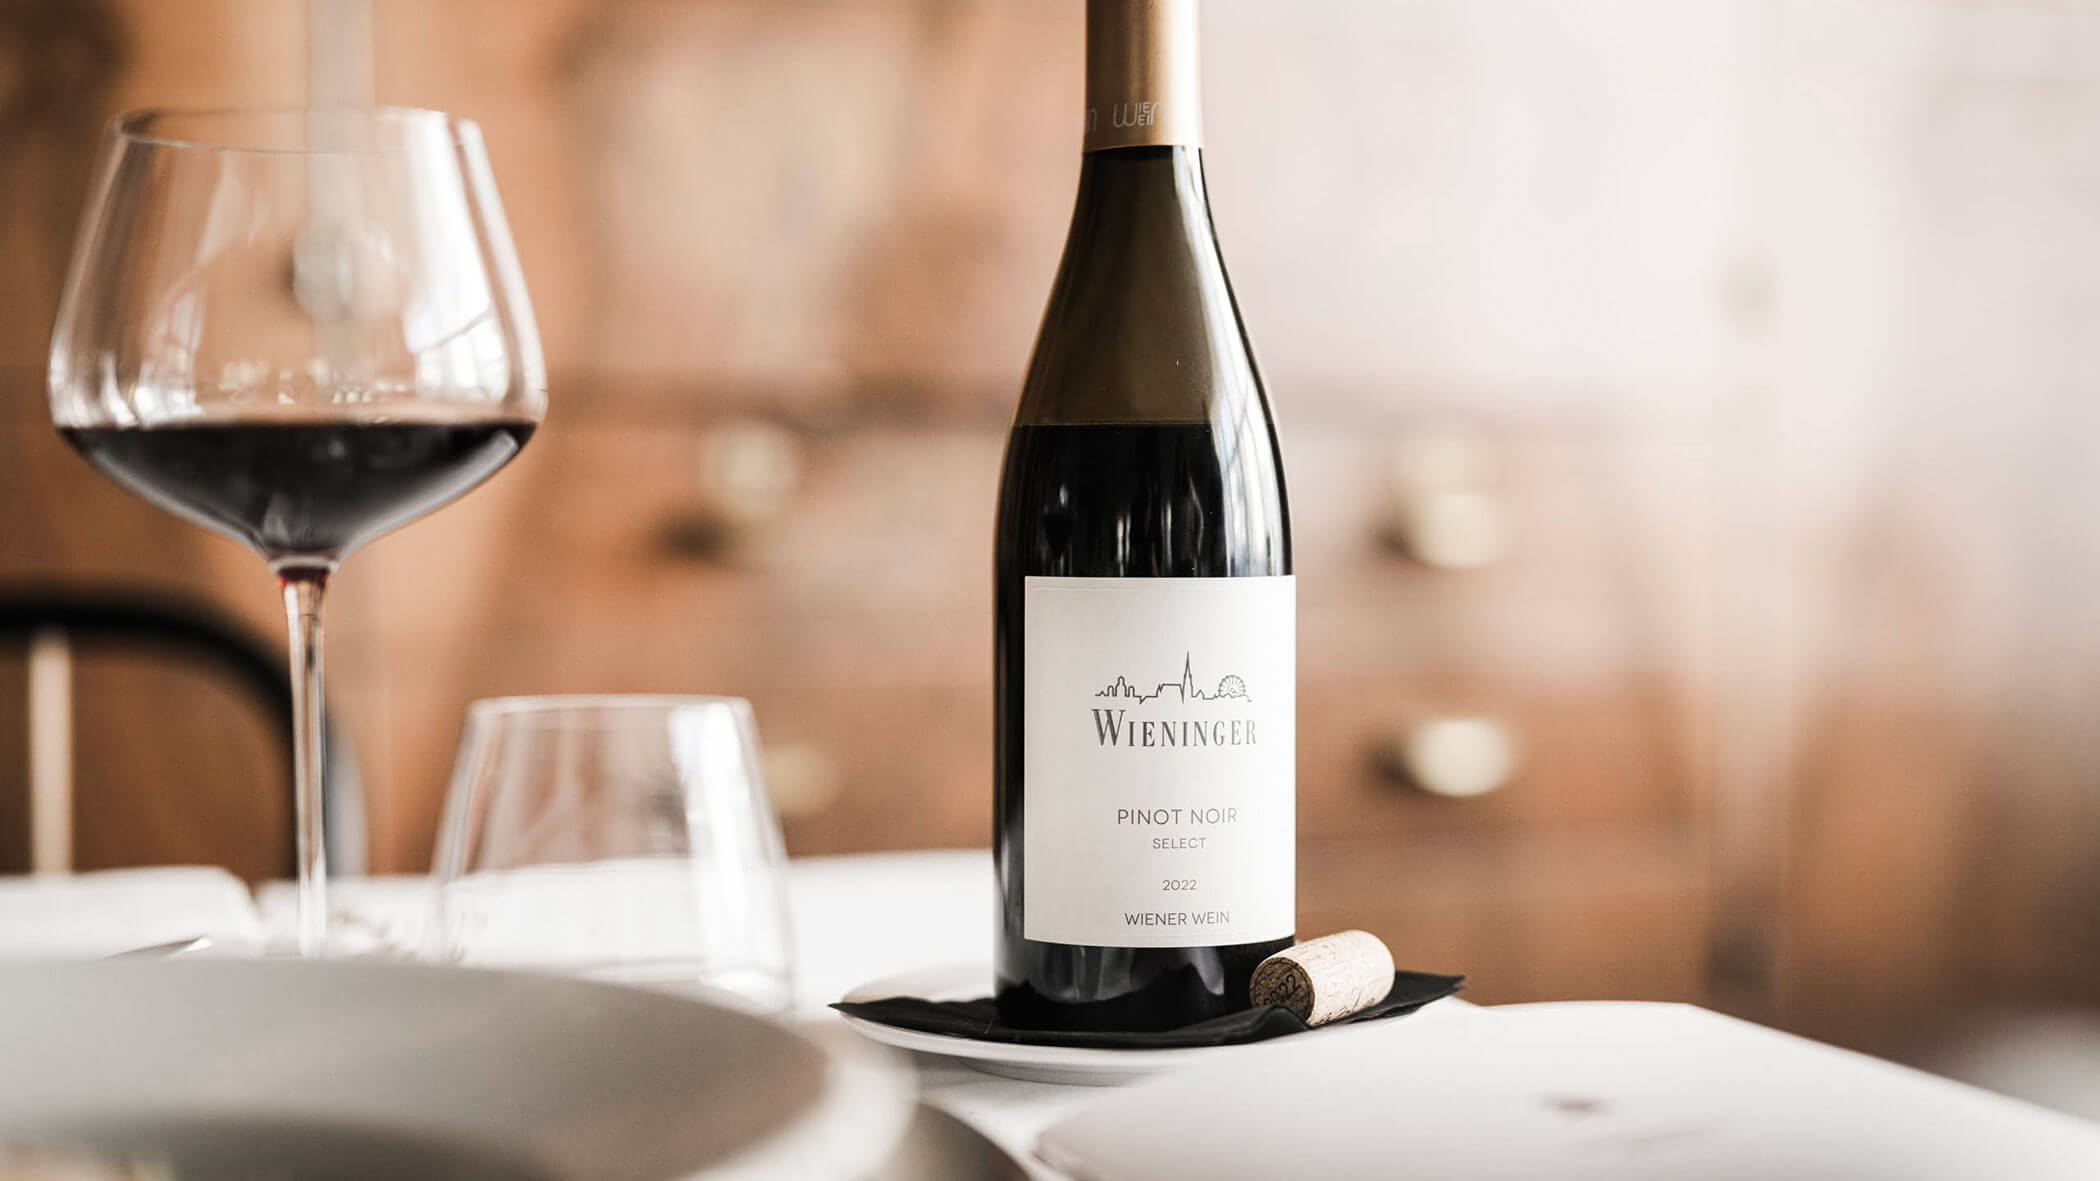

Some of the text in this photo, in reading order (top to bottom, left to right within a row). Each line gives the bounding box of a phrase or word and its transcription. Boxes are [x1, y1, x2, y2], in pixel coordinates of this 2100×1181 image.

[1091, 708, 1257, 748] WIENINGER
[1117, 807, 1238, 825] PINOT NOIR
[1152, 837, 1207, 850] SELECT
[1162, 879, 1198, 891] 2022
[1124, 911, 1230, 926] WIENER WEIN
